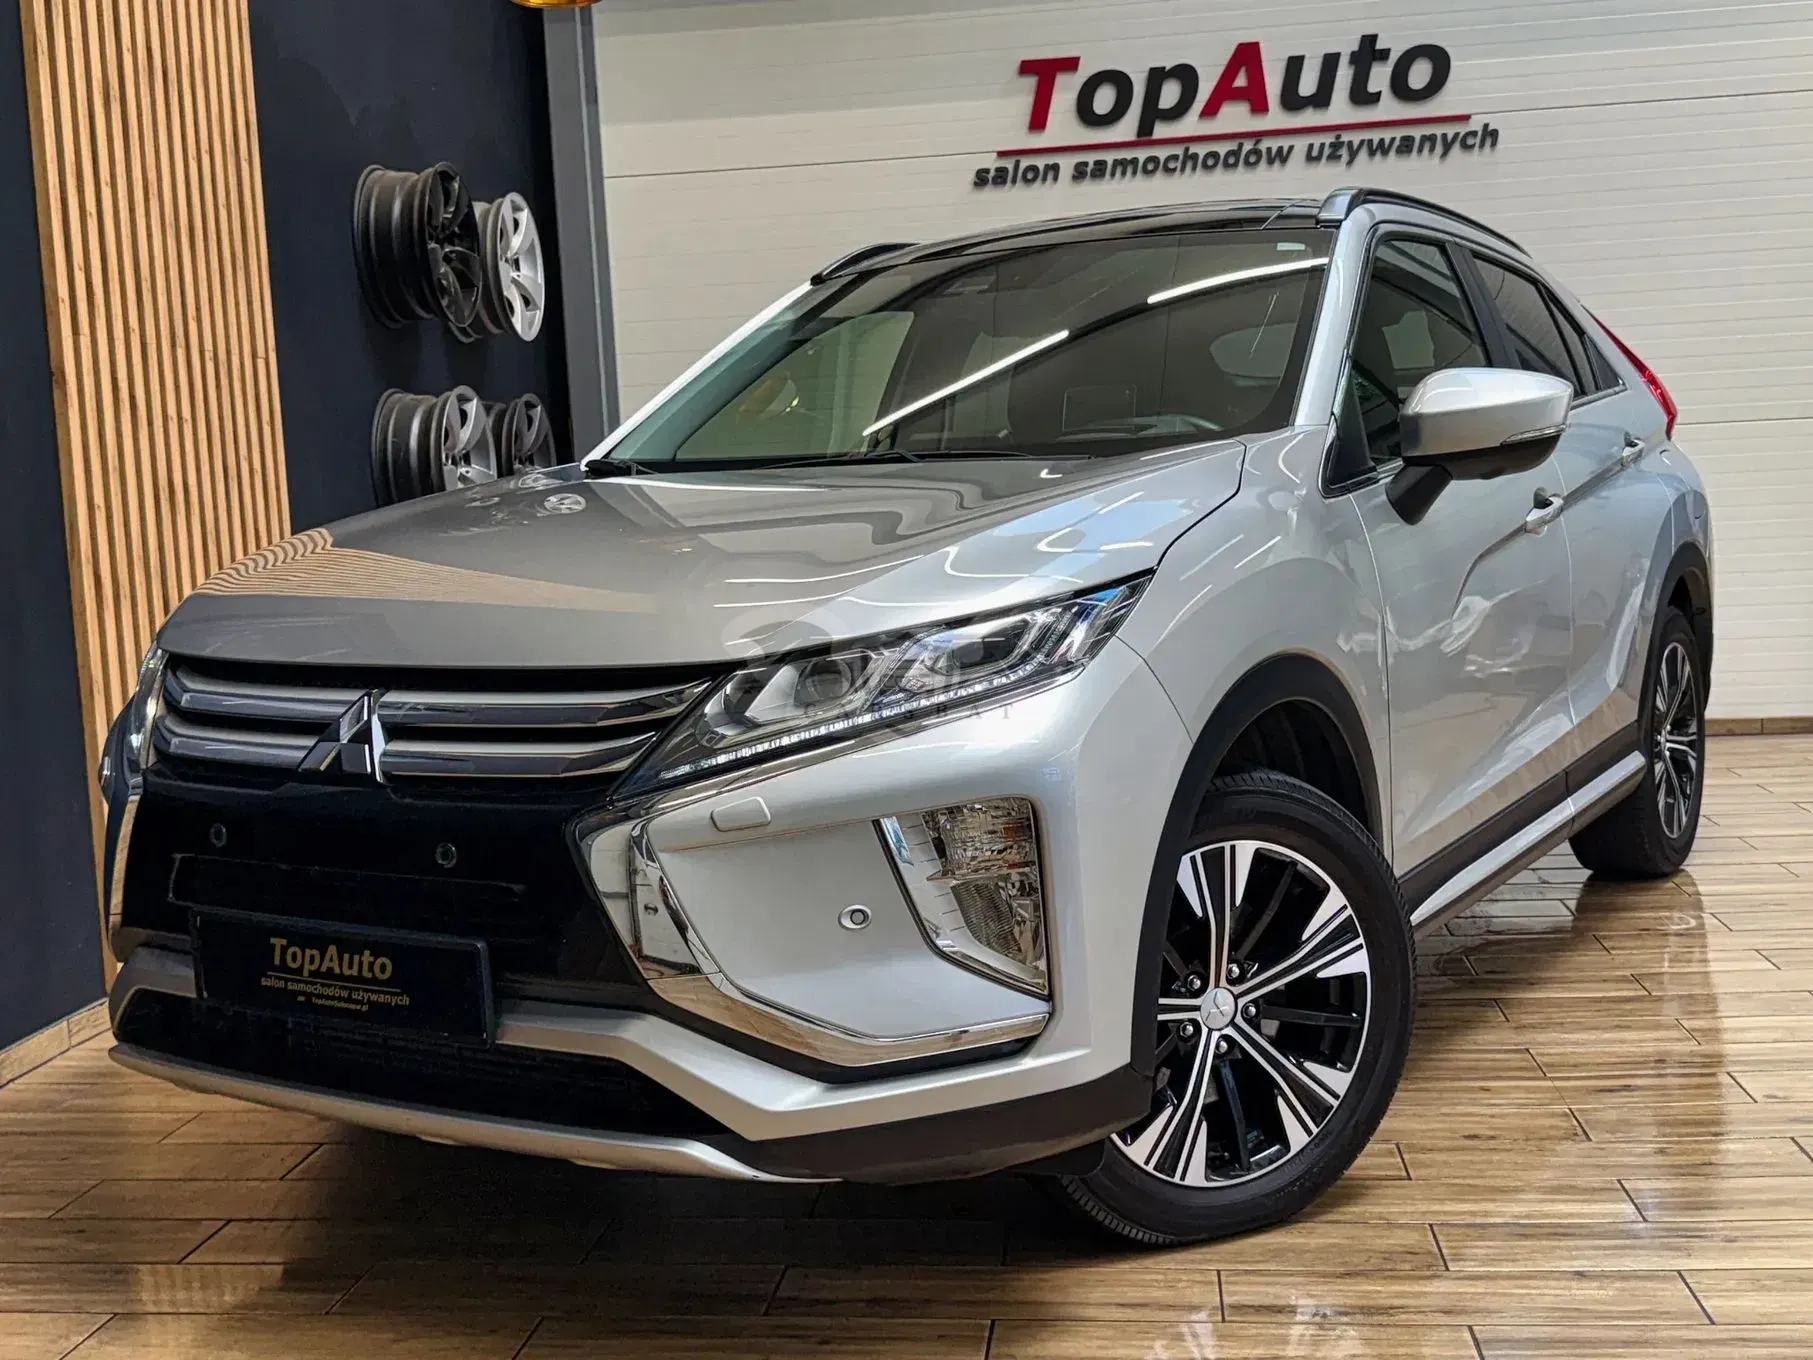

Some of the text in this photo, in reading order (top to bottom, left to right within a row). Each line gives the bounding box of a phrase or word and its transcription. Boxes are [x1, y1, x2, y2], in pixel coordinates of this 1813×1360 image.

[1018, 33, 1452, 138] TopAuto
[973, 122, 1499, 188] salon samochodów używanych
[270, 937, 393, 980] TopAuto
[261, 976, 285, 989] salon
[287, 981, 350, 998] samochodów
[351, 989, 410, 1007] używanych
